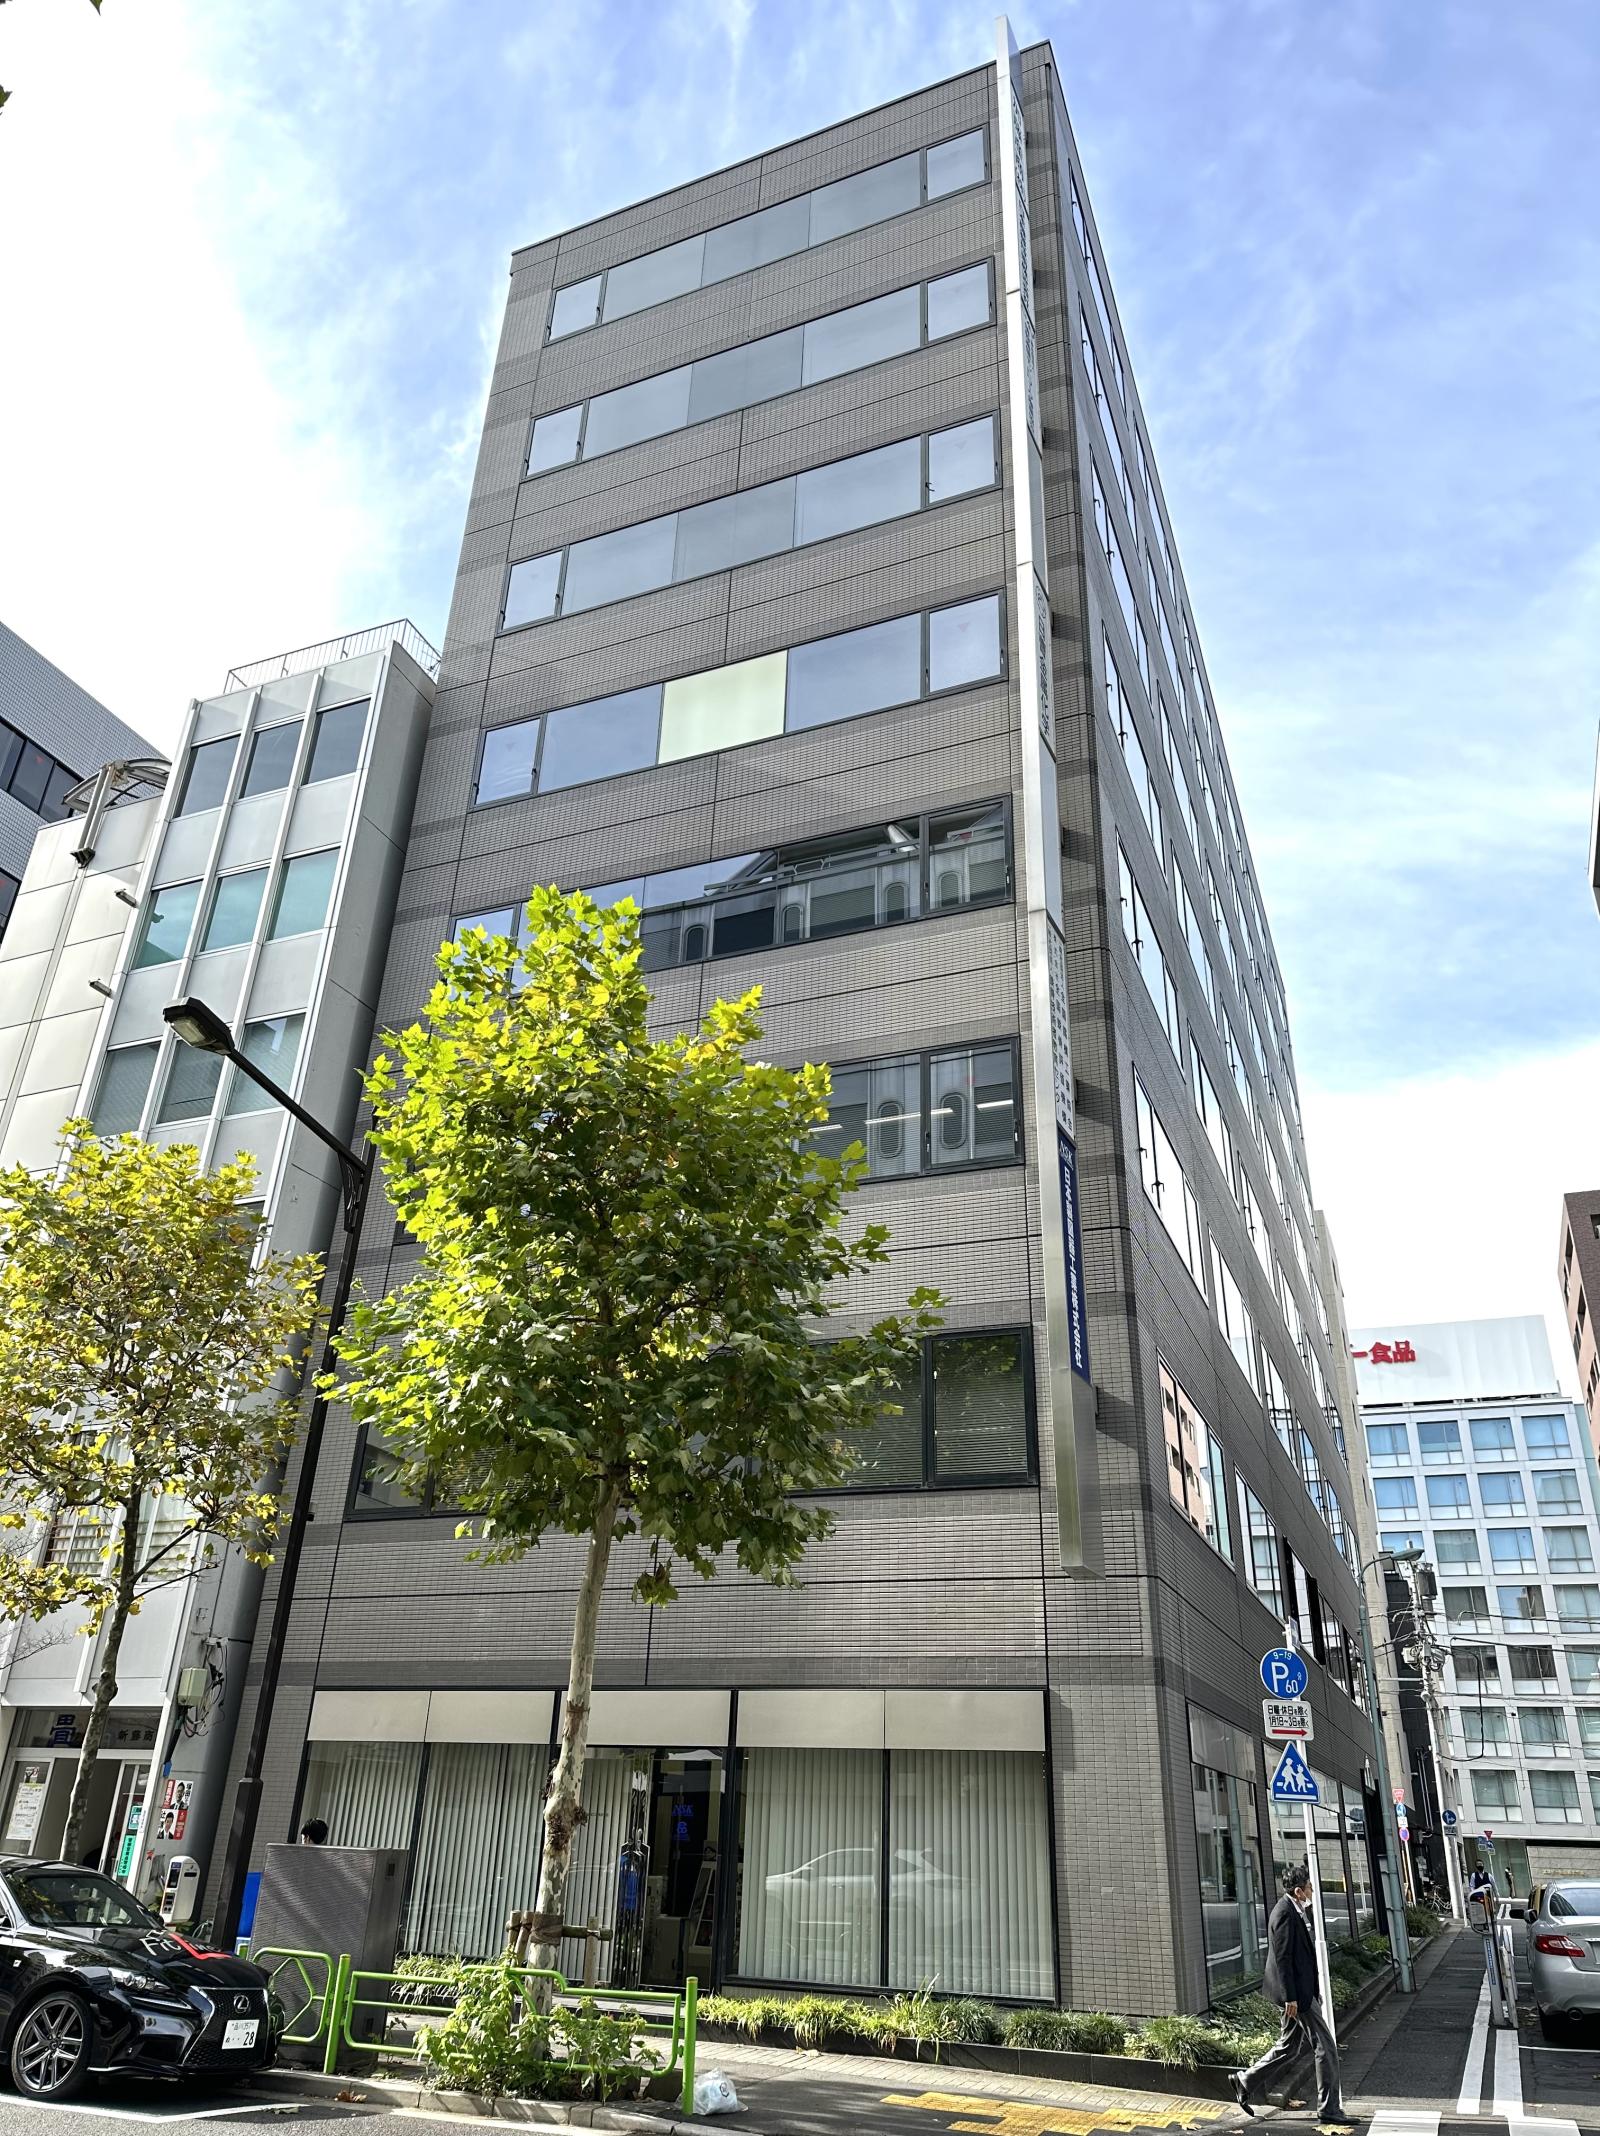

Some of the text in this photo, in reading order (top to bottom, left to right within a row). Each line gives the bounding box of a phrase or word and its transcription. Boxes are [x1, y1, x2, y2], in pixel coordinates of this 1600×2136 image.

[1061, 1141, 1073, 1167] NSK
[1273, 1651, 1292, 1660] 9-19
[1271, 1661, 1289, 1693] P
[1285, 1679, 1299, 1694] 60
